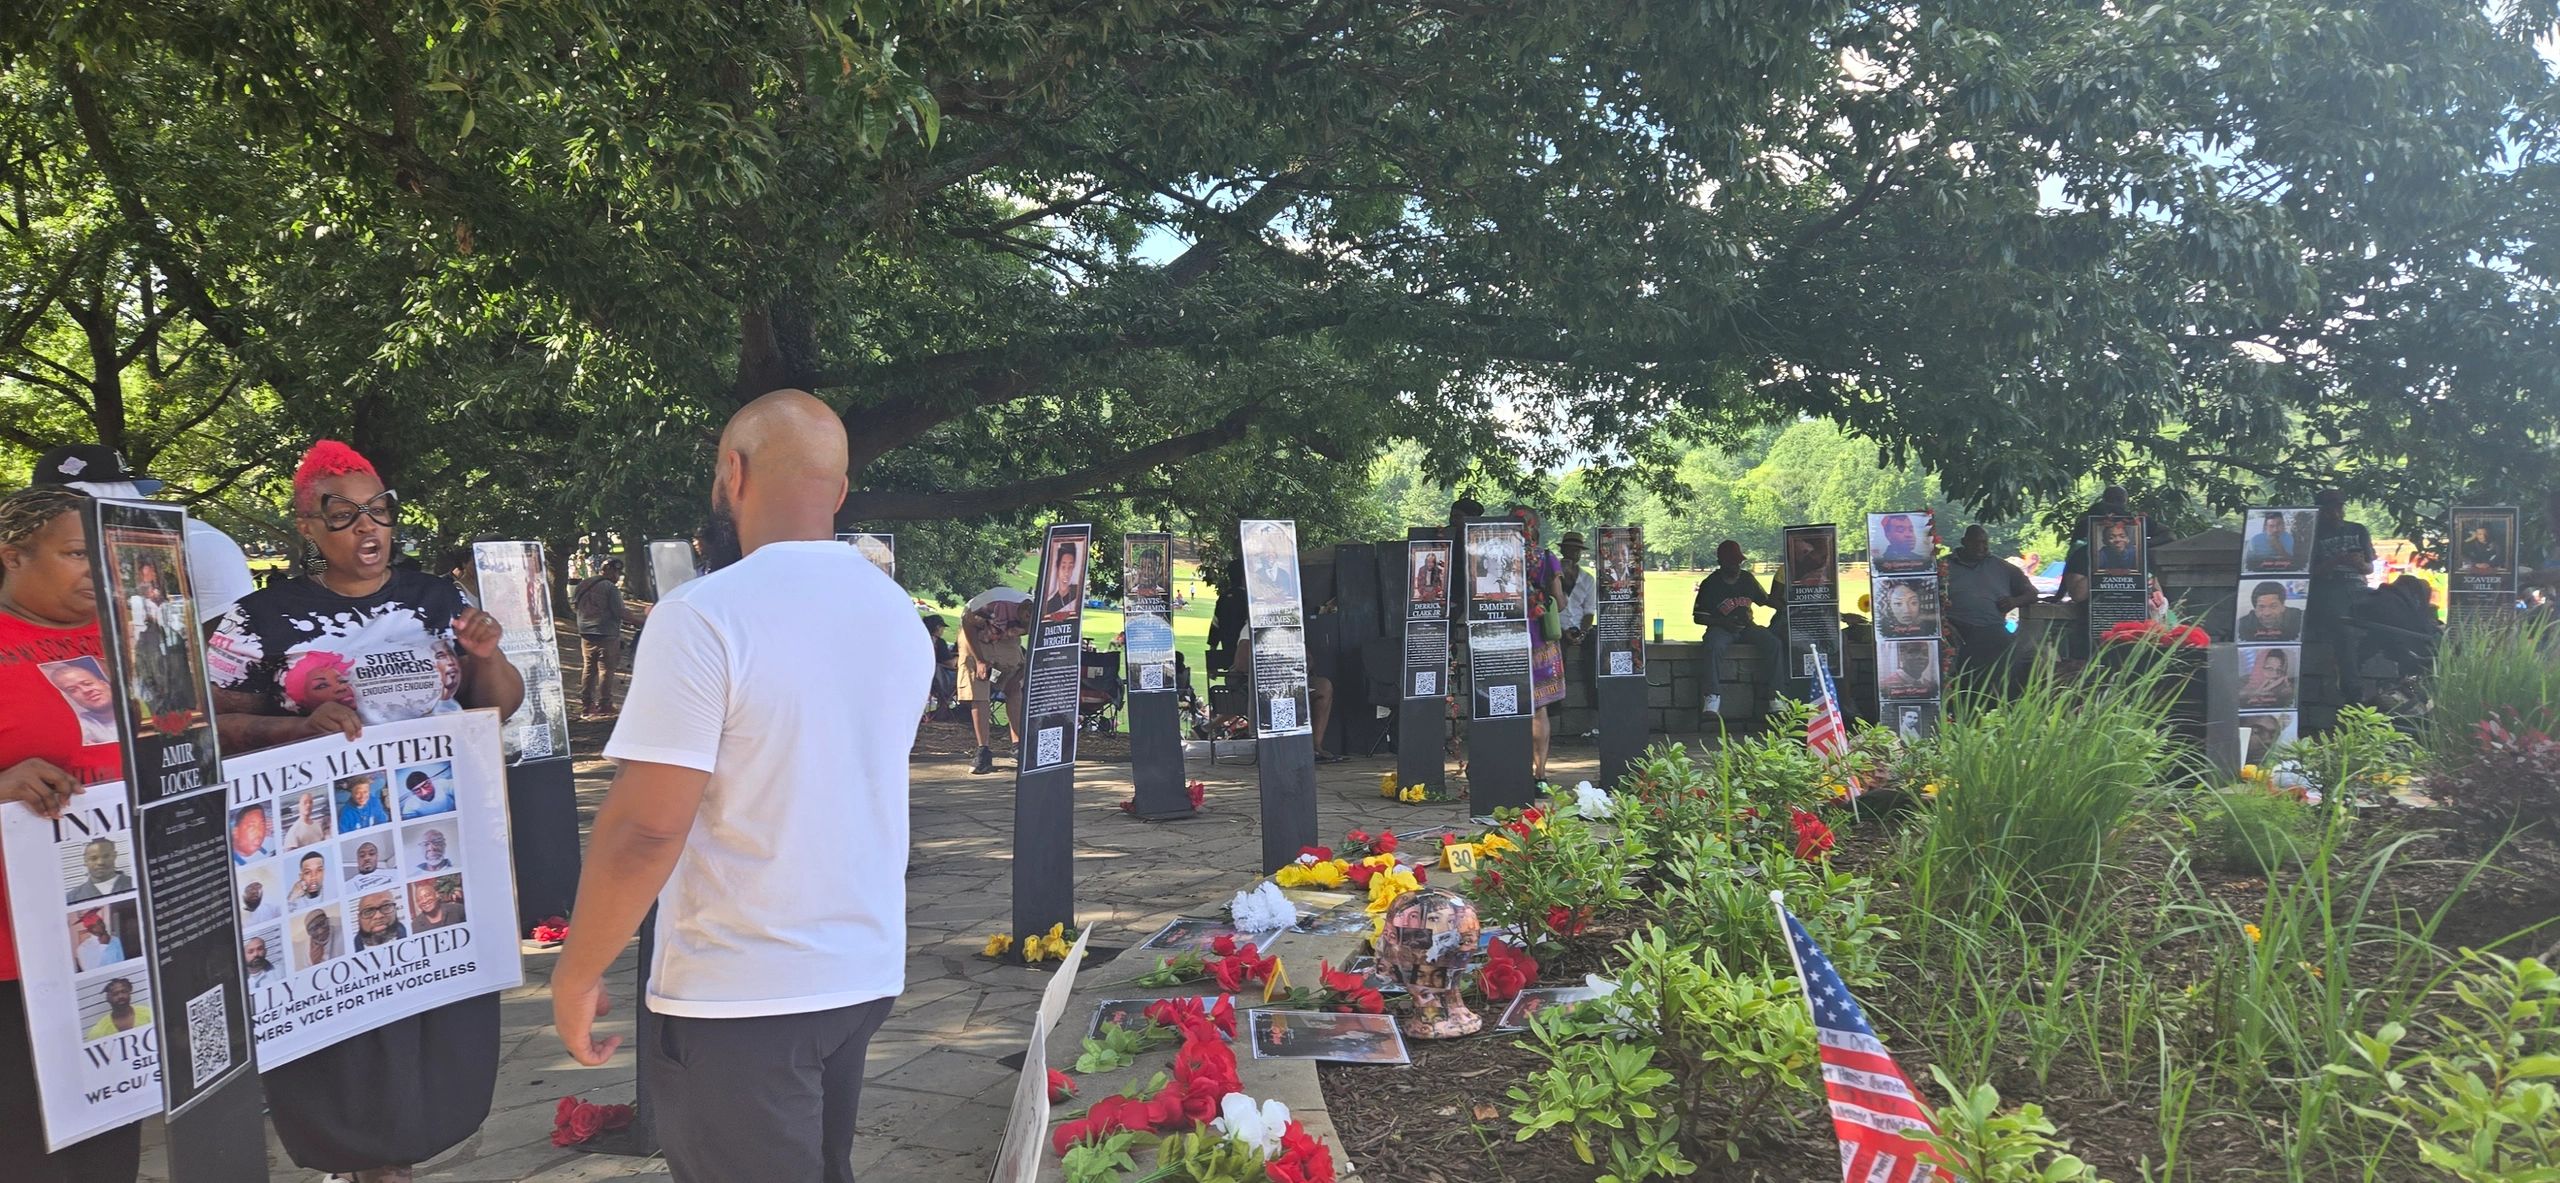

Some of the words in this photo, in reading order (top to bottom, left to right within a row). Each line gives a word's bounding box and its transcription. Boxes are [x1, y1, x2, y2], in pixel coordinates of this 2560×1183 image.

[1795, 586, 1830, 594] HOWARD
[1414, 602, 1441, 610] DERRICK
[1479, 602, 1516, 611] EMMETT
[1487, 611, 1507, 619] TILL
[1044, 623, 1072, 637] DAUNTE
[1043, 634, 1072, 647] WRIGHT
[365, 649, 417, 666] STREET
[355, 658, 435, 680] GROOMERS
[361, 684, 395, 697] ENOUGH
[394, 683, 404, 692] IS
[403, 680, 435, 692] ENOUGH
[162, 742, 196, 768] AMIR
[232, 760, 313, 805] LIVES
[325, 734, 455, 780] MATTER
[160, 767, 201, 797] LOCKE
[1451, 849, 1472, 868] 30
[312, 926, 471, 991] CONVICTED
[284, 990, 333, 1016] MENTAL
[335, 973, 381, 998] HEALTH
[382, 958, 431, 981] MATTER
[298, 1005, 334, 1027] VICE
[337, 994, 365, 1014] FOR
[366, 984, 394, 1002] THE
[396, 961, 477, 992] VOICELESS
